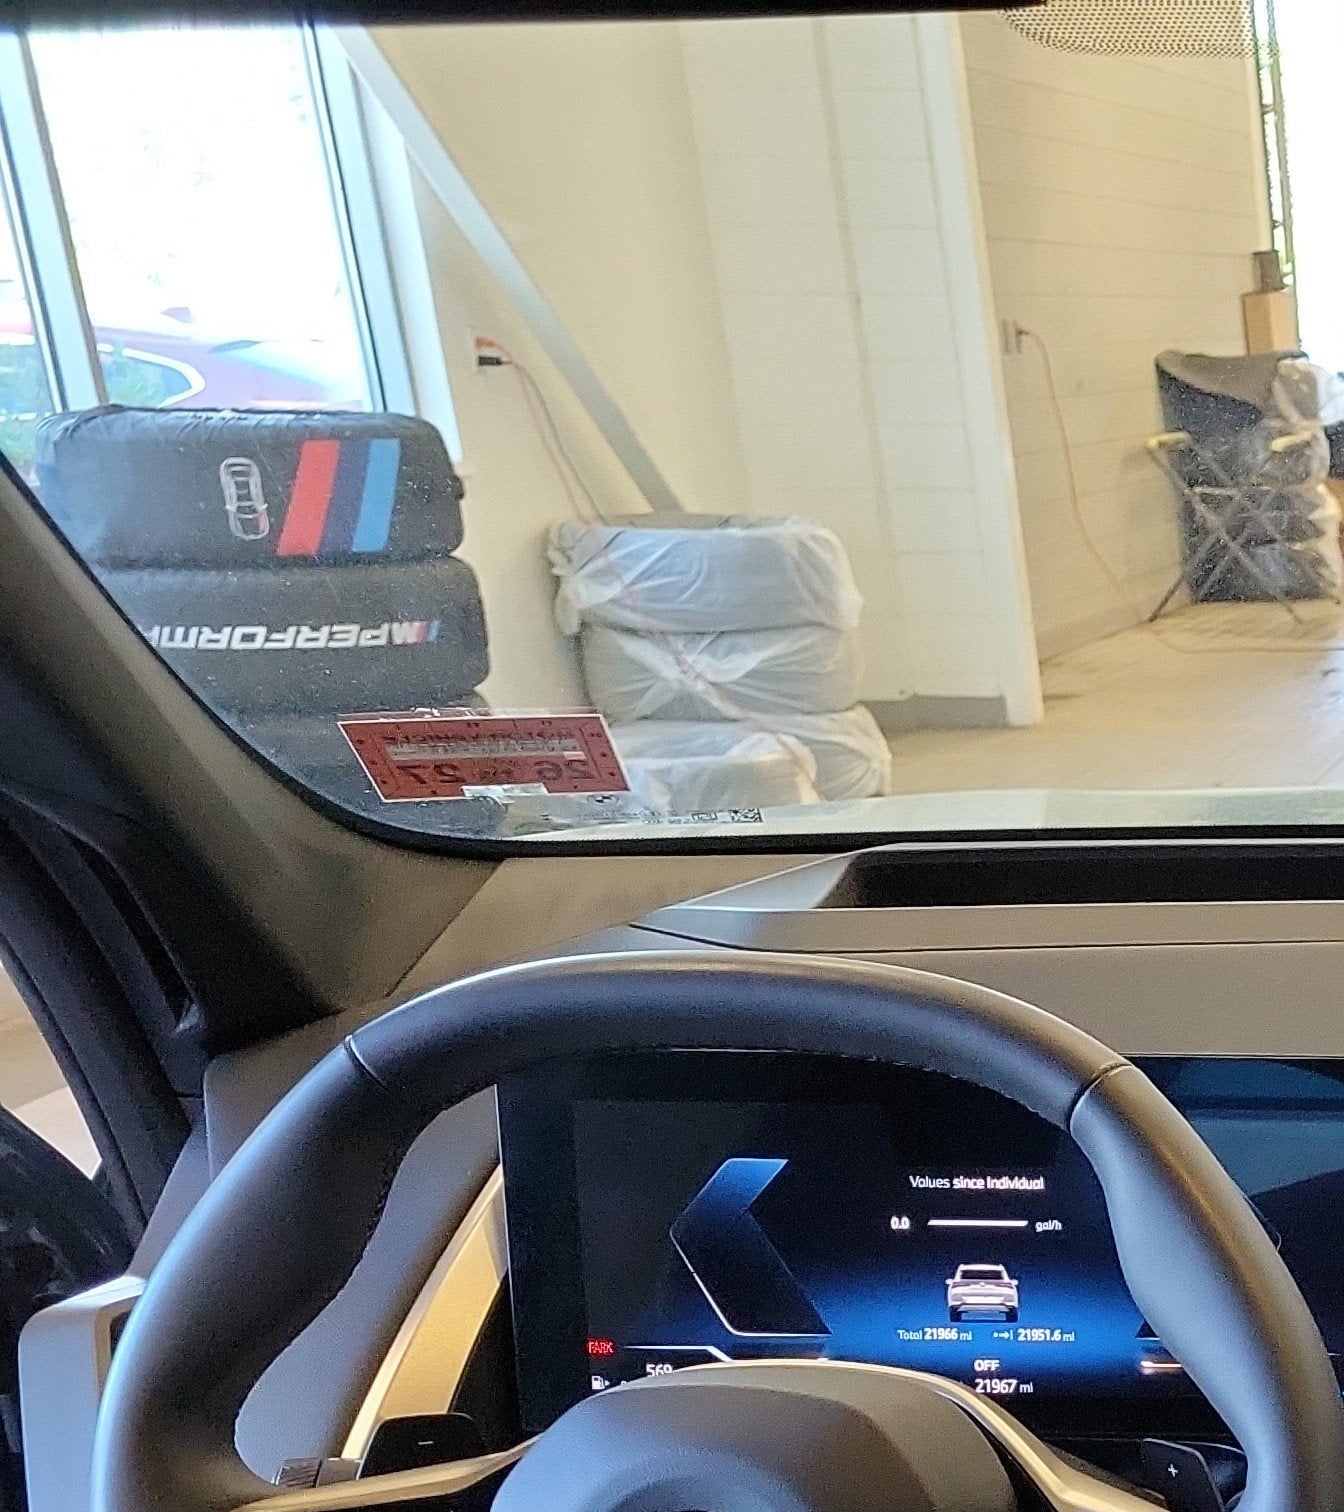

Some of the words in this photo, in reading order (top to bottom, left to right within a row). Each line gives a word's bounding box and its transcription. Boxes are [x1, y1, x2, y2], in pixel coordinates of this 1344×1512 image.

[908, 1175, 951, 1189] Values
[952, 1176, 985, 1190] since
[923, 1327, 959, 1341] 21966
[1017, 1328, 1062, 1342] 21951.6
[588, 1340, 615, 1354] PARK
[973, 1358, 1001, 1372] OFF
[974, 1378, 1018, 1394] 21967
